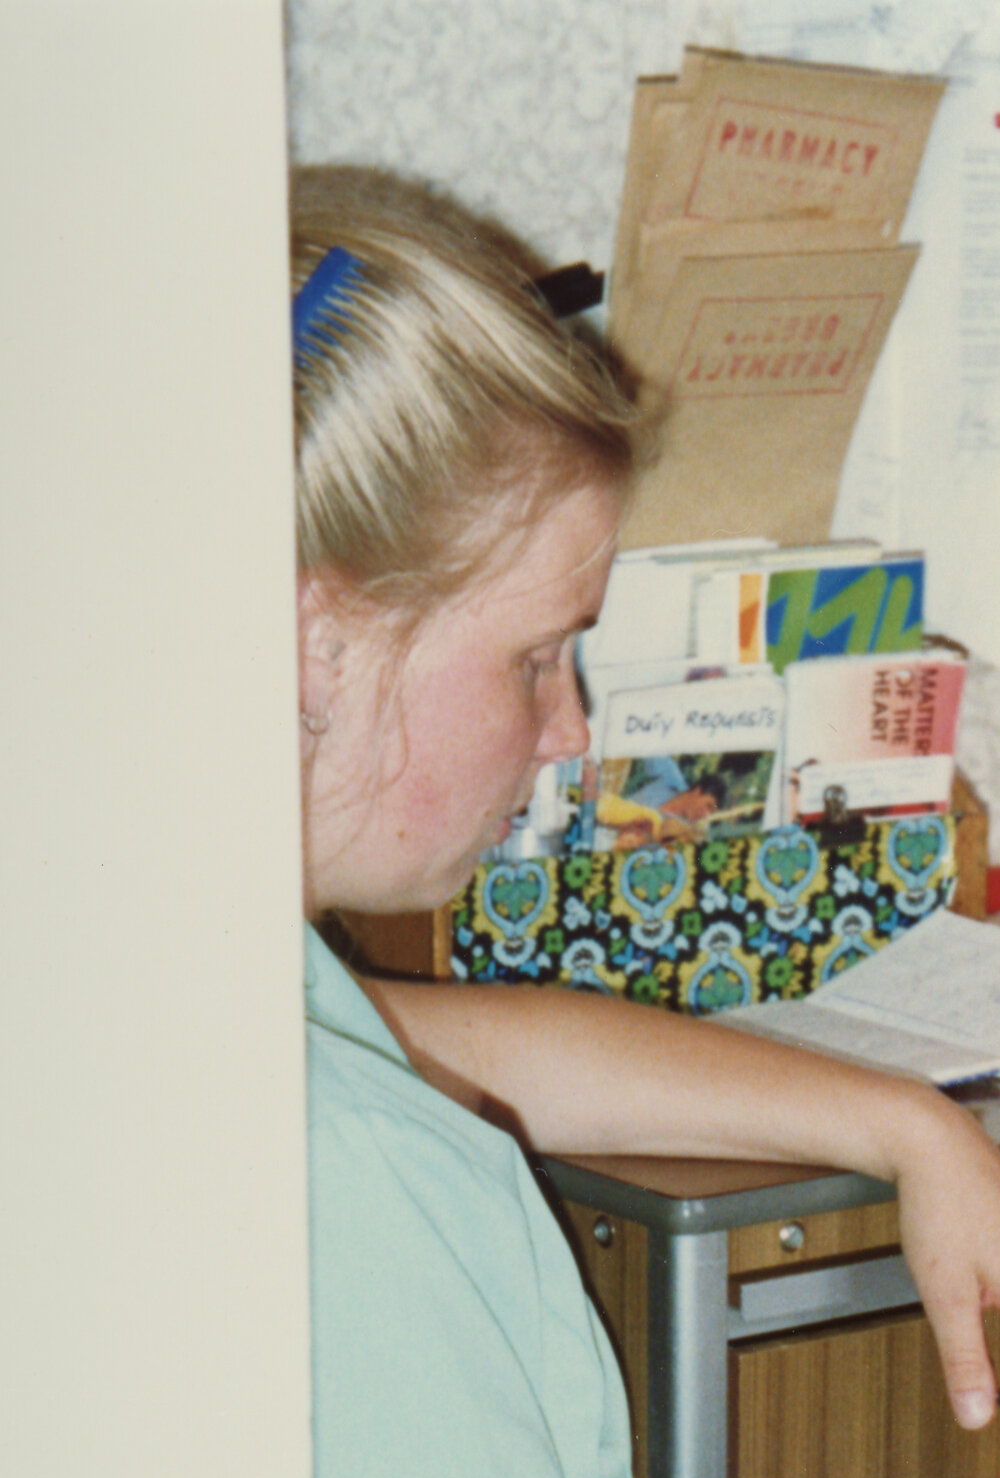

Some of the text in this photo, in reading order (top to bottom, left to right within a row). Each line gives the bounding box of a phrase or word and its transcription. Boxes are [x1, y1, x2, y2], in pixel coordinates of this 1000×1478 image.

[718, 119, 880, 176] PHARMACY
[685, 345, 850, 383] PHARMACY
[870, 669, 892, 742] HEART
[891, 707, 911, 746] THE
[912, 667, 939, 756] MATTER
